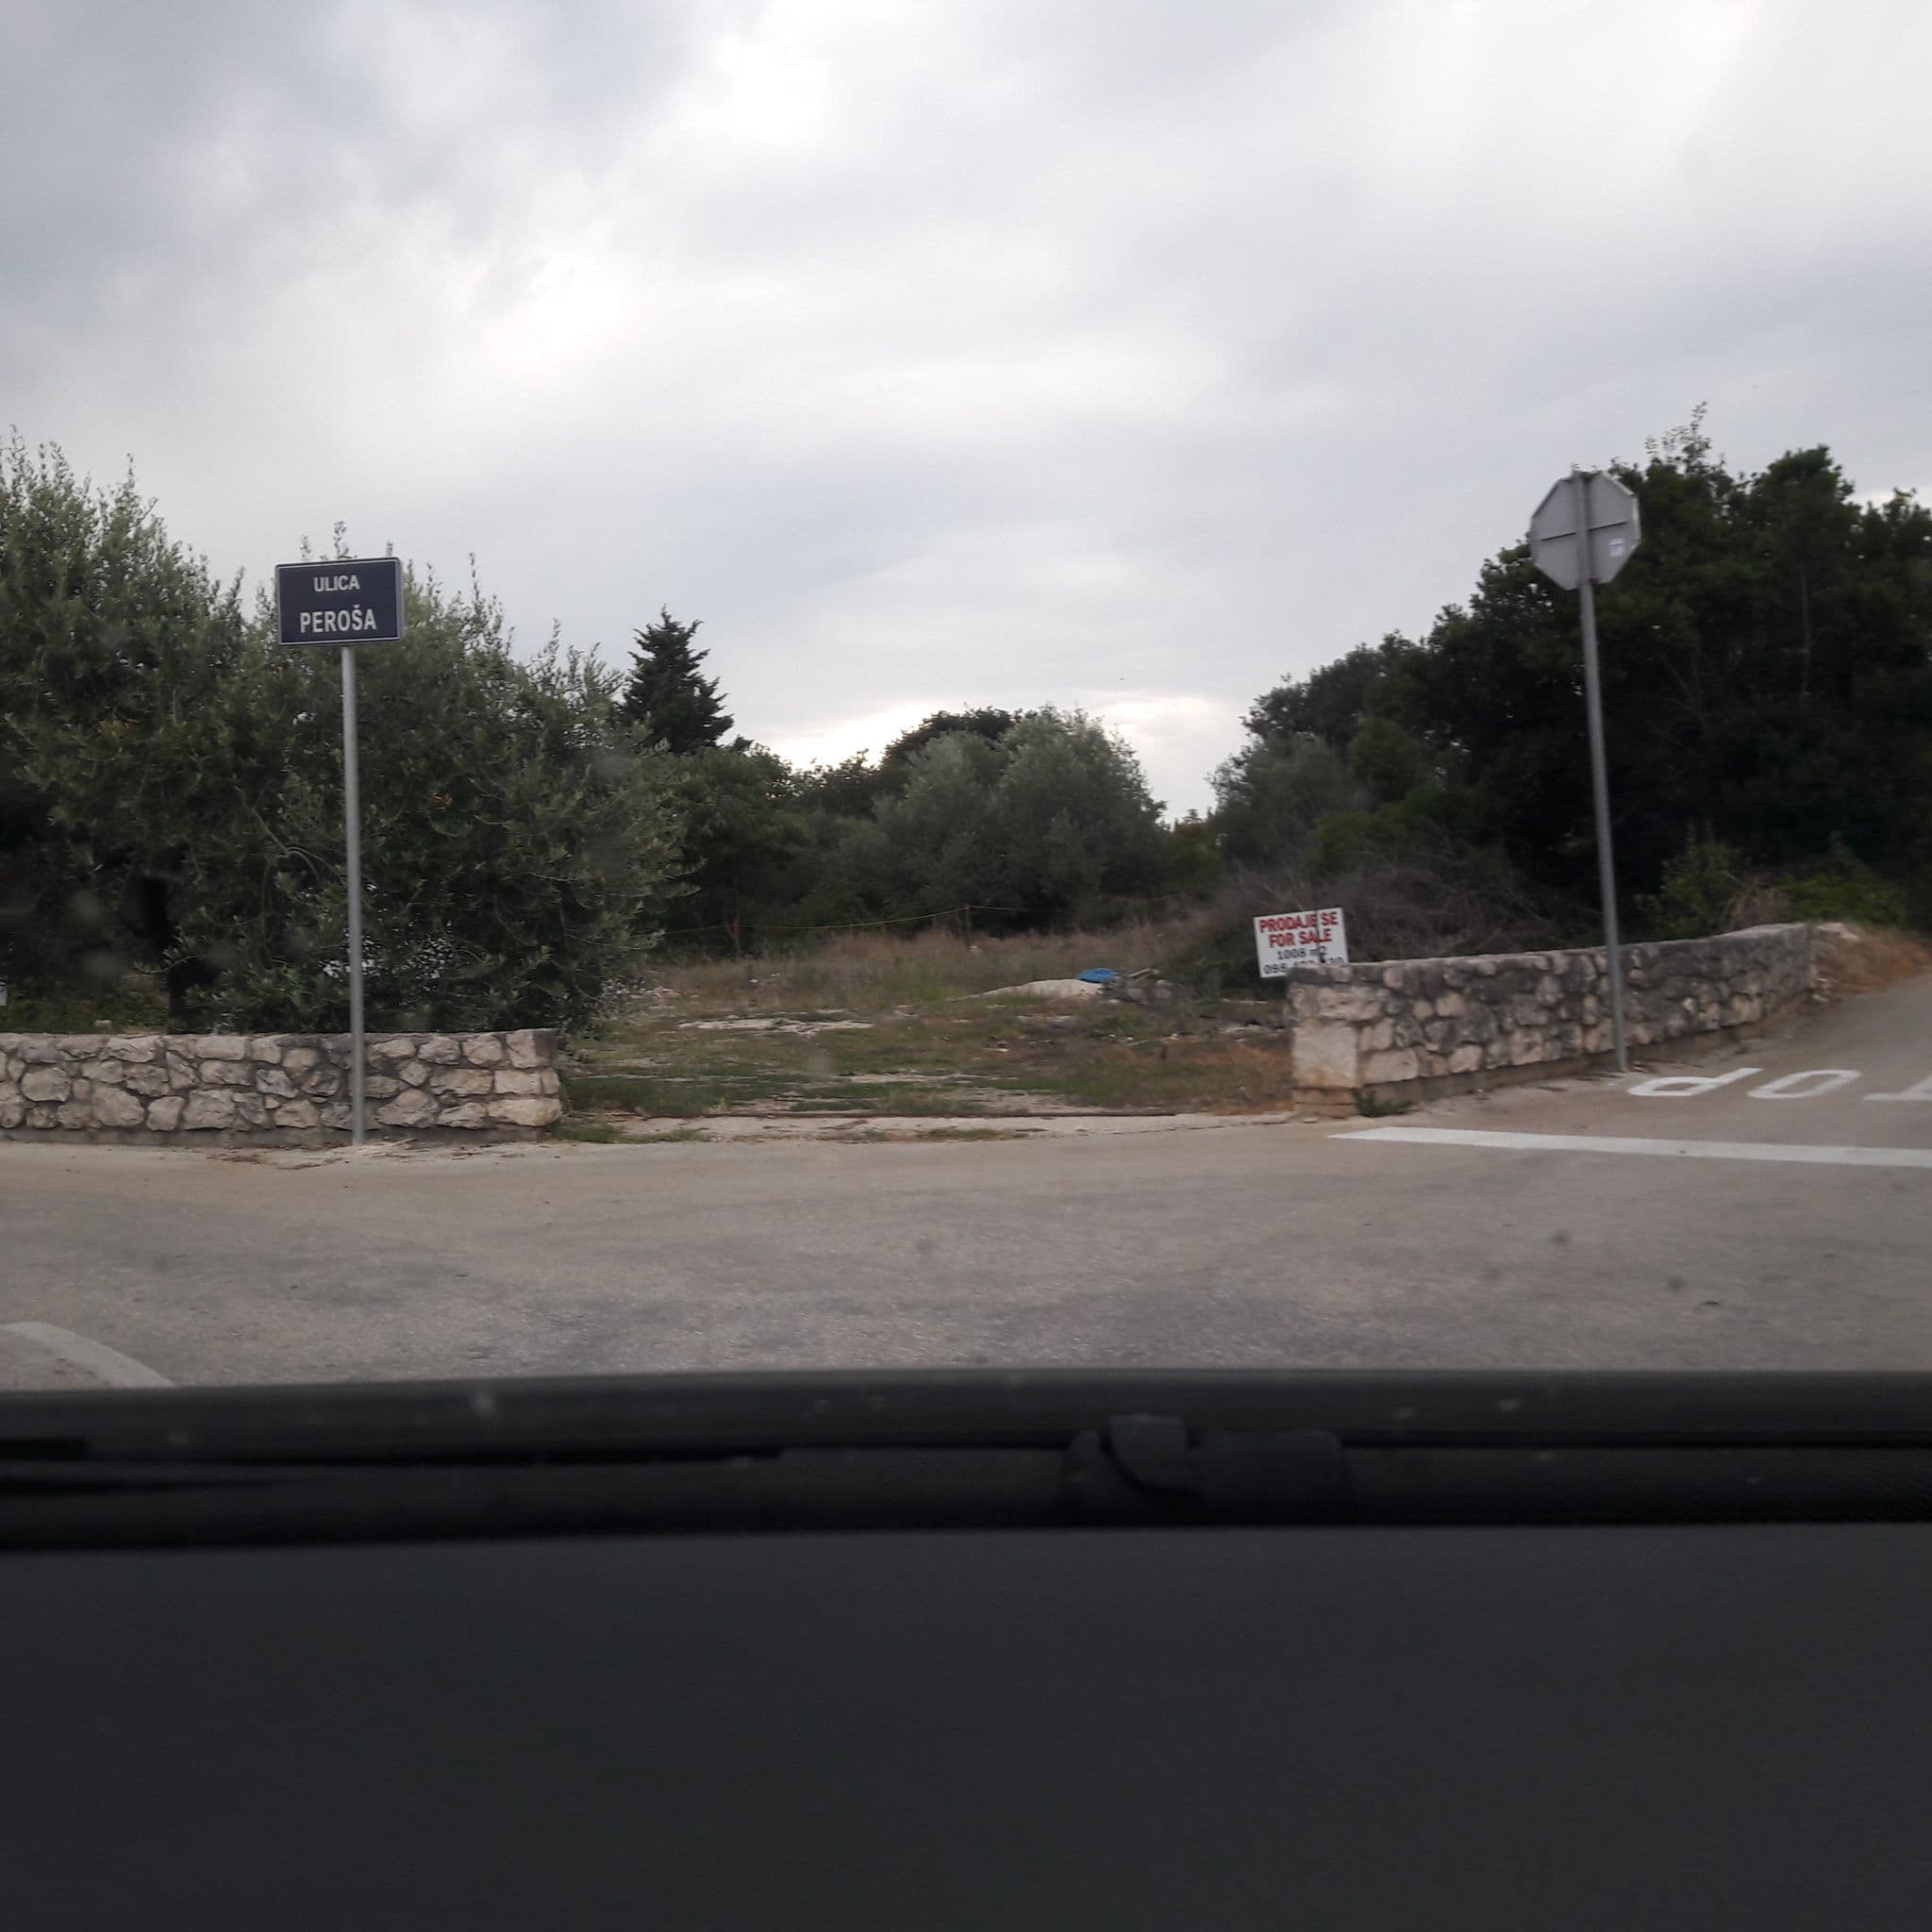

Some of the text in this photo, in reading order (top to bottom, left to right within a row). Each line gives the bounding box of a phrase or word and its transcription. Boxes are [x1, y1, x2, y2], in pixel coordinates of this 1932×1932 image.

[313, 575, 360, 592] ULICA
[299, 604, 377, 633] PEROŠA
[1259, 911, 1338, 933] PRODAJE SE
[1269, 928, 1332, 948] FOR SALE
